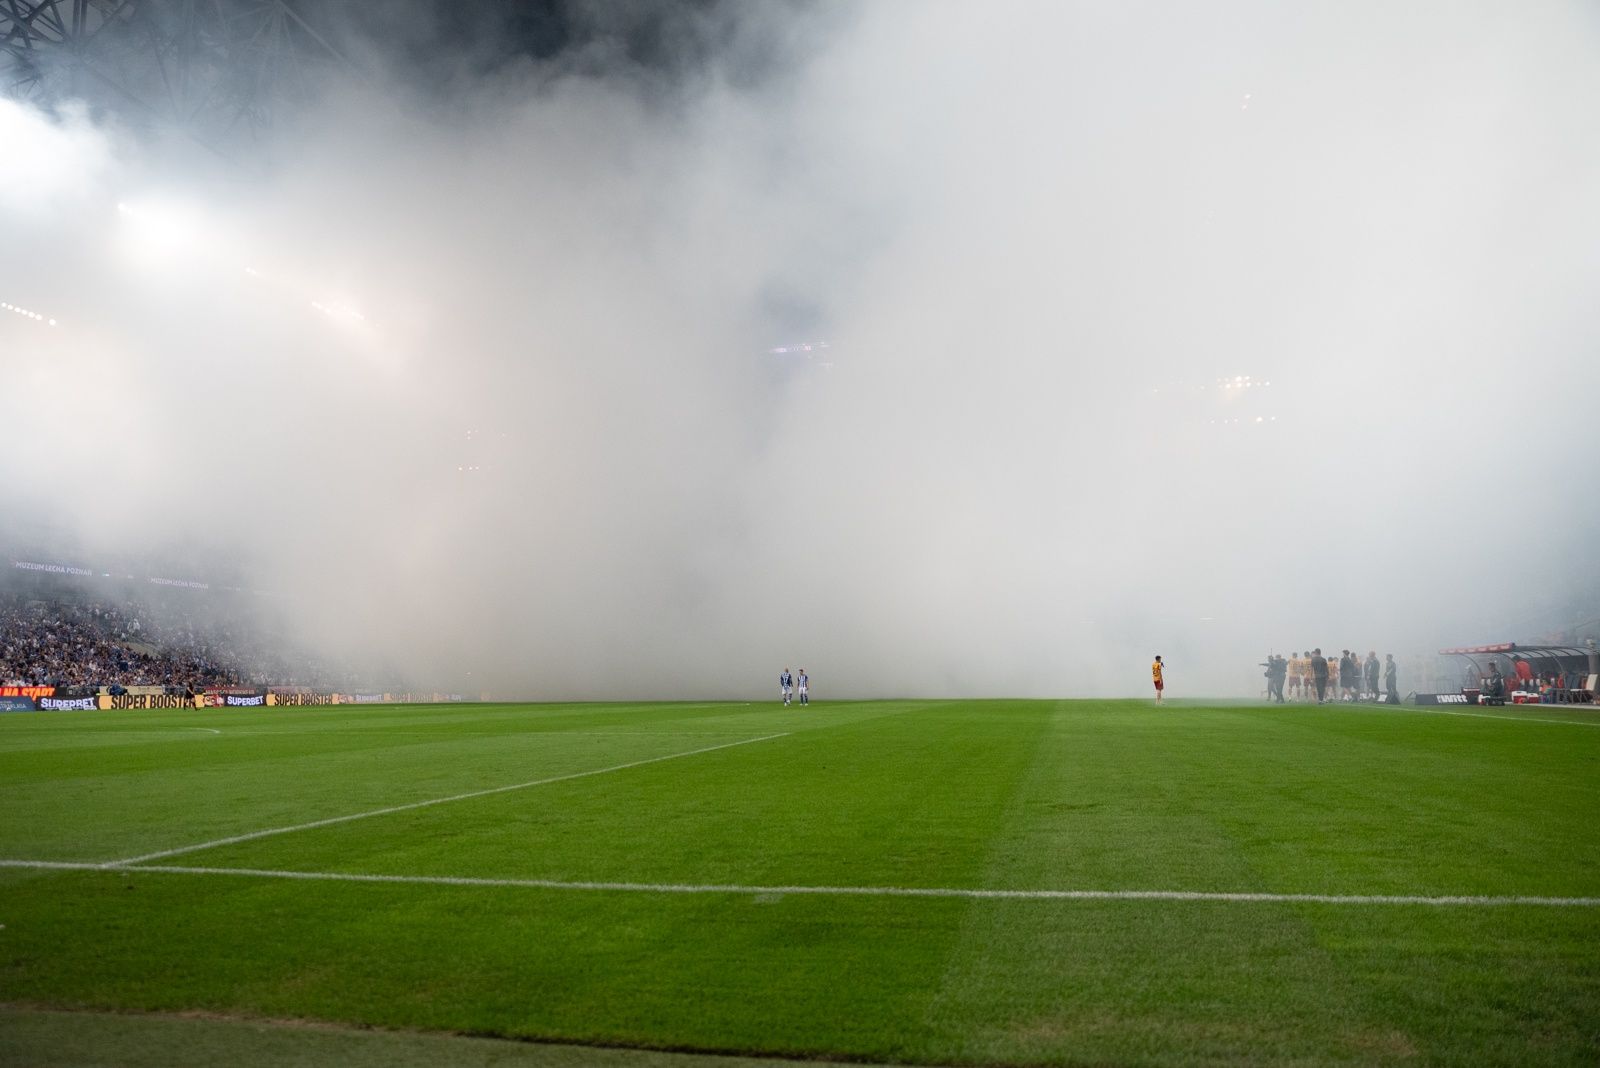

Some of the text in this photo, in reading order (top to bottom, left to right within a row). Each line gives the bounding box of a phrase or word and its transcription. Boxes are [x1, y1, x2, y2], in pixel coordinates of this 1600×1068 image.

[16, 561, 45, 571] MUZEUM
[45, 564, 65, 573] LECHA
[3, 687, 55, 702] NA START
[227, 695, 264, 706] SUPERBET
[275, 693, 299, 706] SUPER
[301, 693, 332, 706] BOOSTER
[111, 695, 147, 710] SUPER
